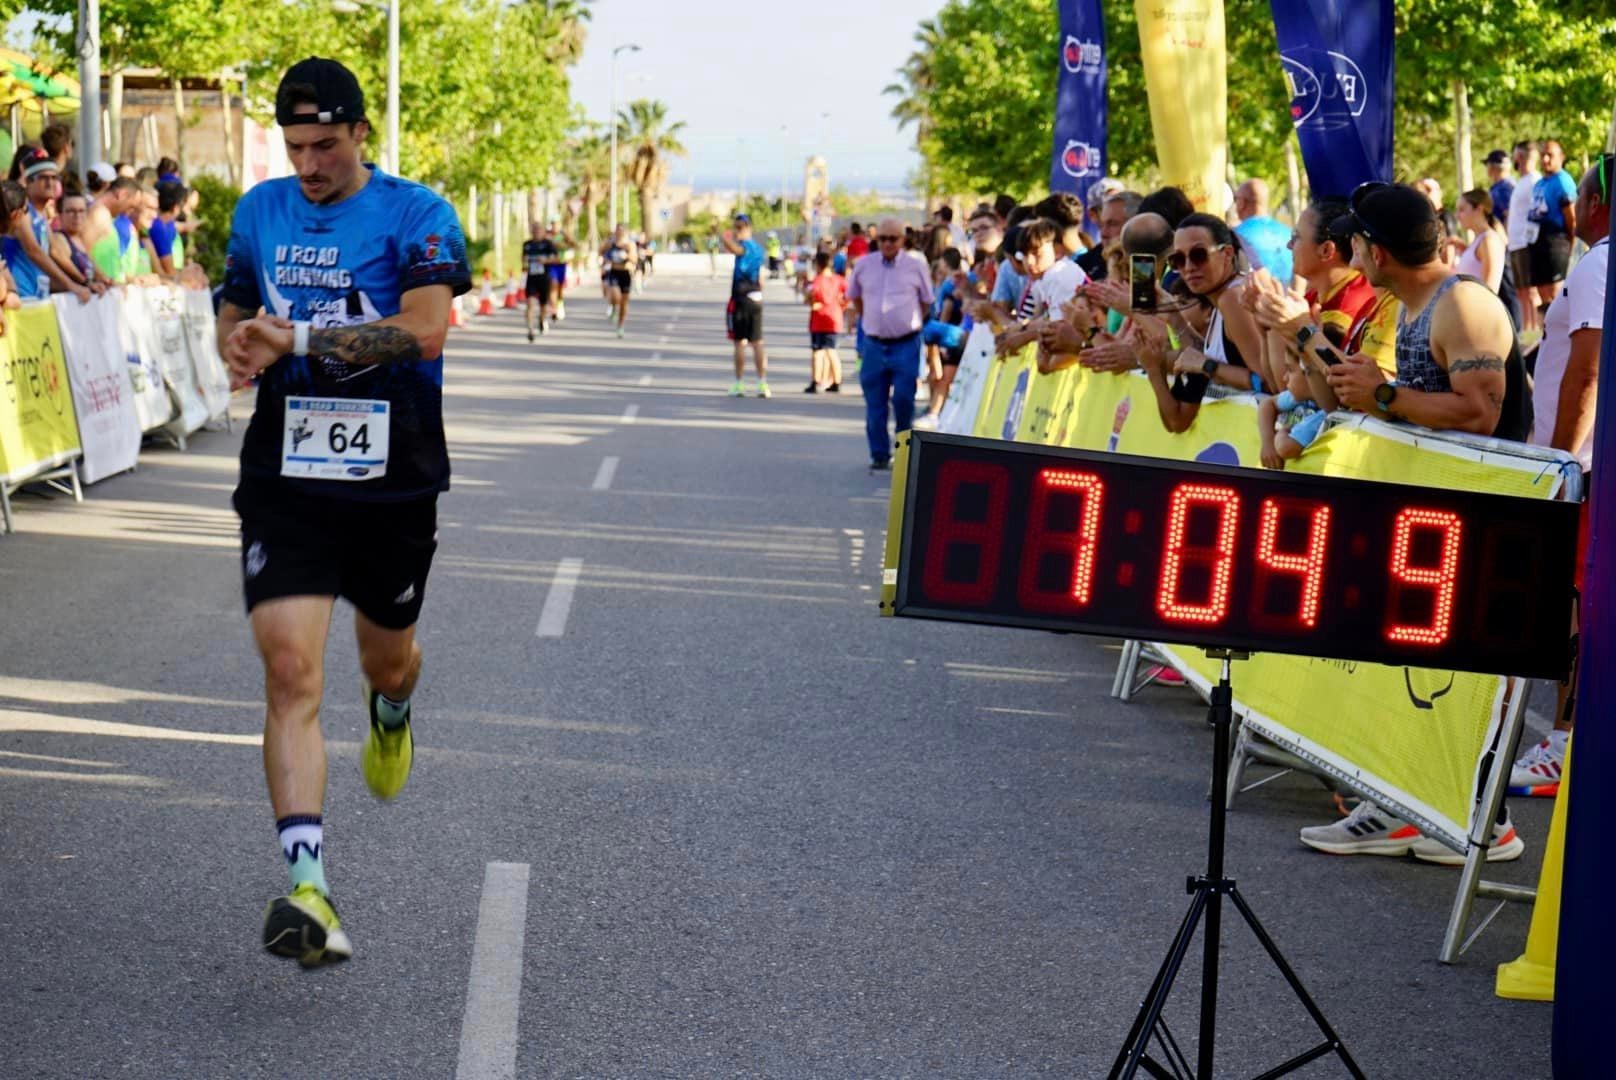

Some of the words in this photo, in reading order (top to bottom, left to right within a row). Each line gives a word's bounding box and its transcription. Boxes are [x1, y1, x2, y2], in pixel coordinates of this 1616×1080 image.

[291, 244, 339, 267] ROAD
[275, 265, 352, 289] RUNNING
[328, 421, 371, 455] 64
